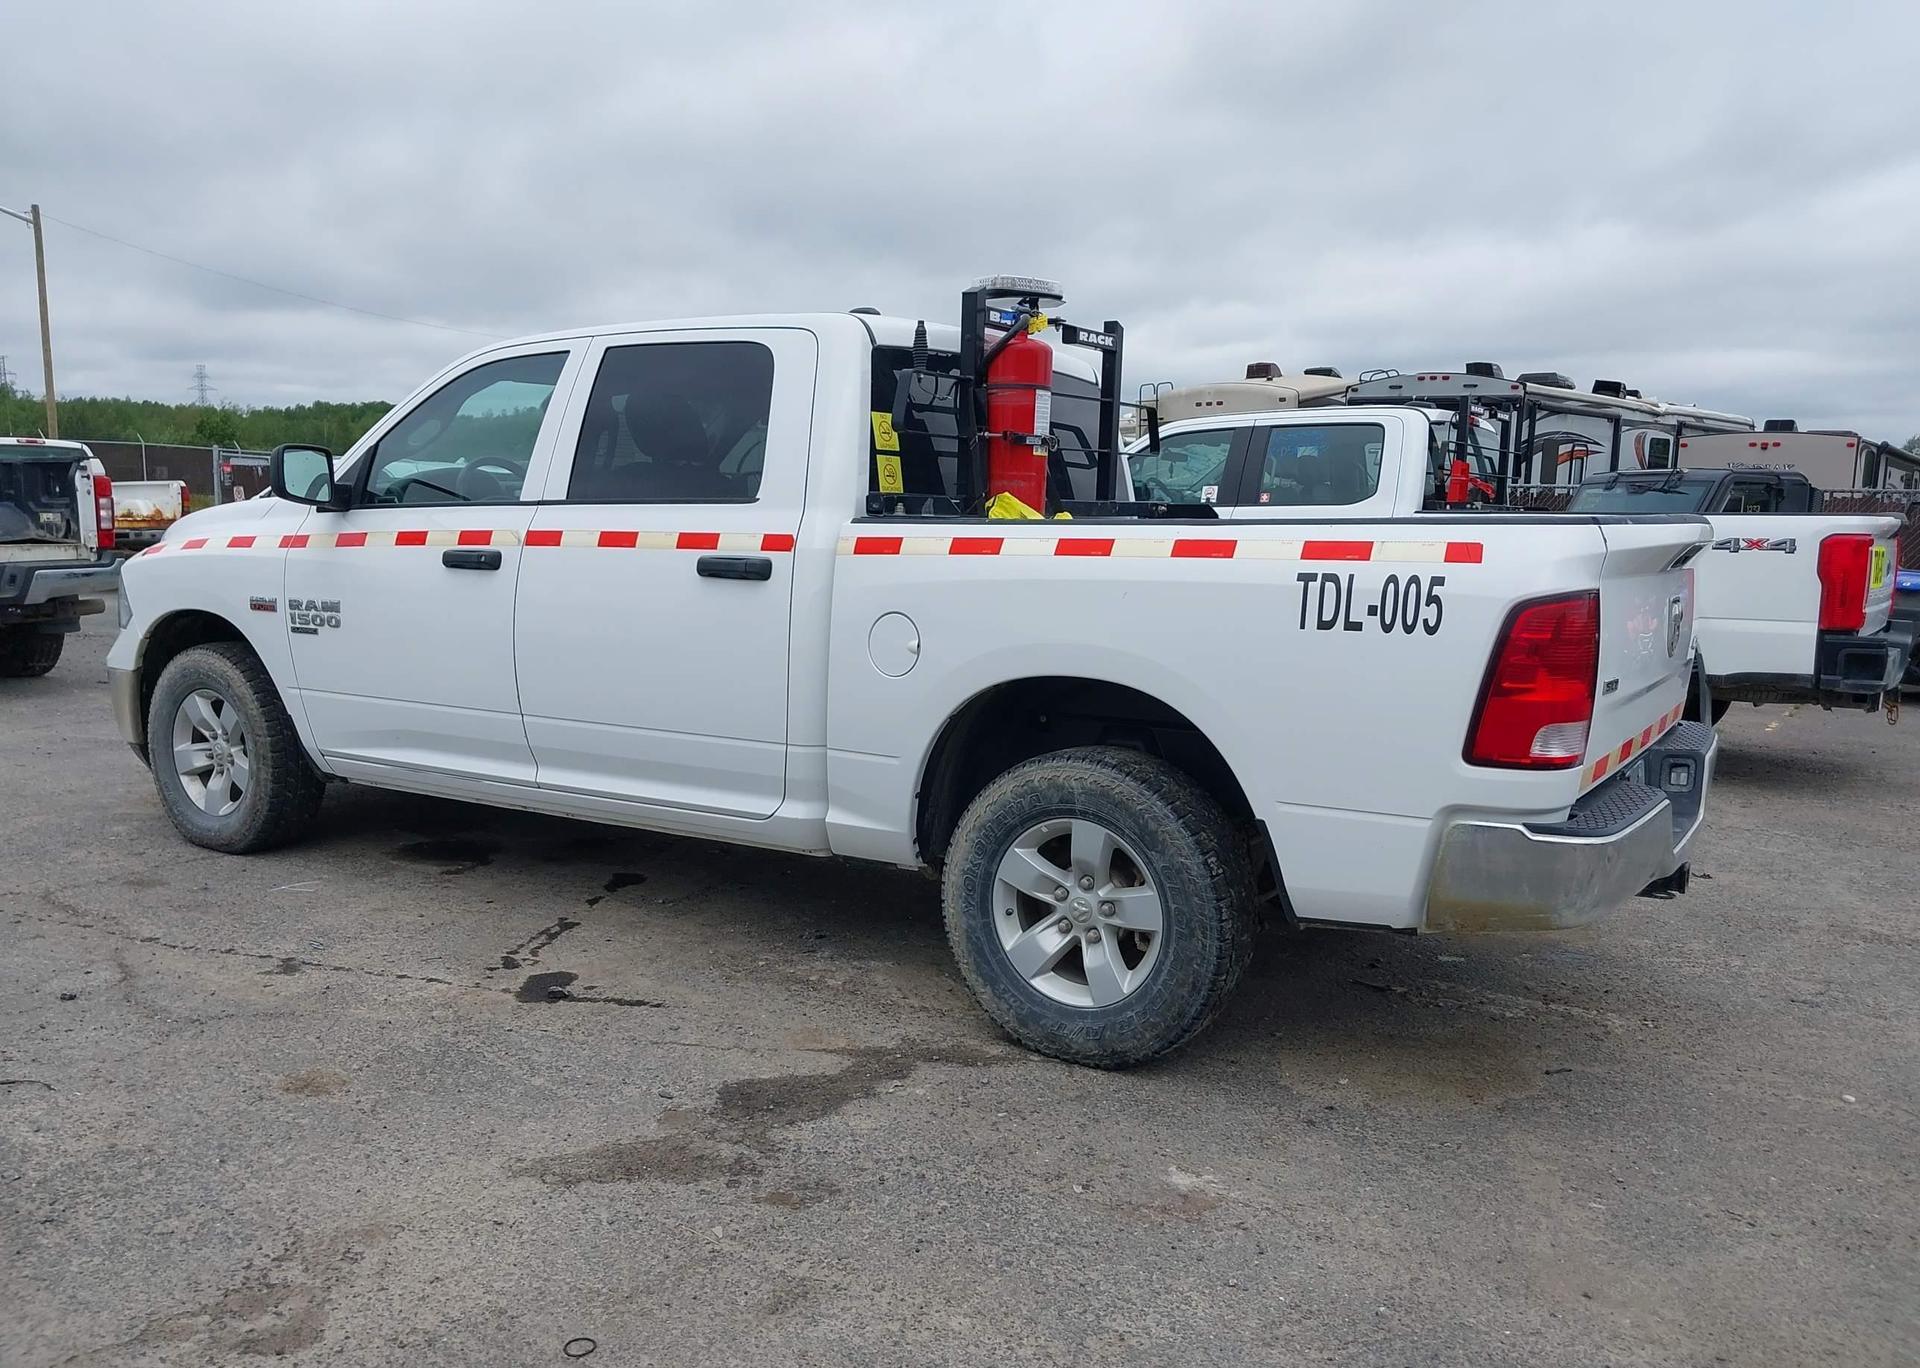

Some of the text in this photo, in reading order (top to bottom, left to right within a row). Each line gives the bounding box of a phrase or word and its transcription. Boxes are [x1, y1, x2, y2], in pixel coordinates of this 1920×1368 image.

[1079, 331, 1114, 347] RACK
[288, 599, 341, 613] RAM
[1296, 572, 1446, 636] TDL-005
[289, 612, 342, 629] 1500
